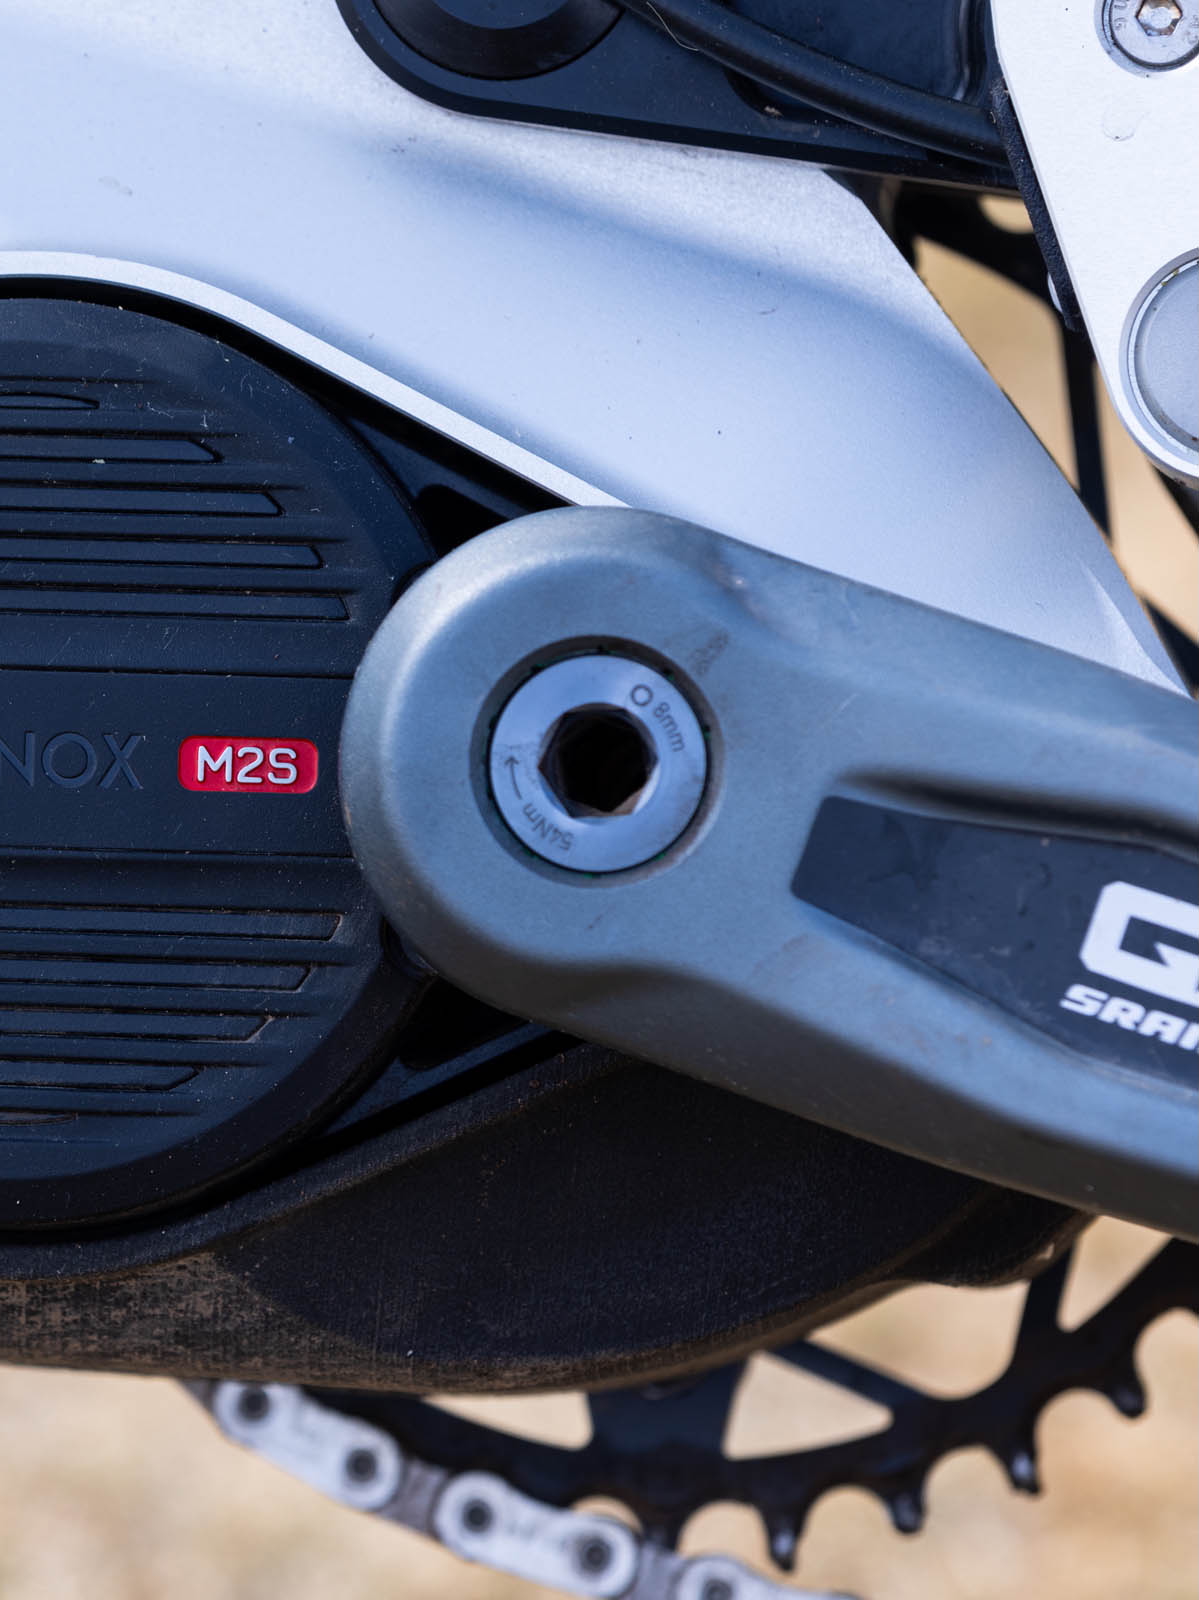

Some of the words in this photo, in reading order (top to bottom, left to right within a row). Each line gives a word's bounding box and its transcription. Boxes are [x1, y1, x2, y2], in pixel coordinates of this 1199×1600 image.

[653, 702, 686, 752] 8mm
[197, 745, 298, 785] M2S
[522, 802, 574, 850] 54Nm
